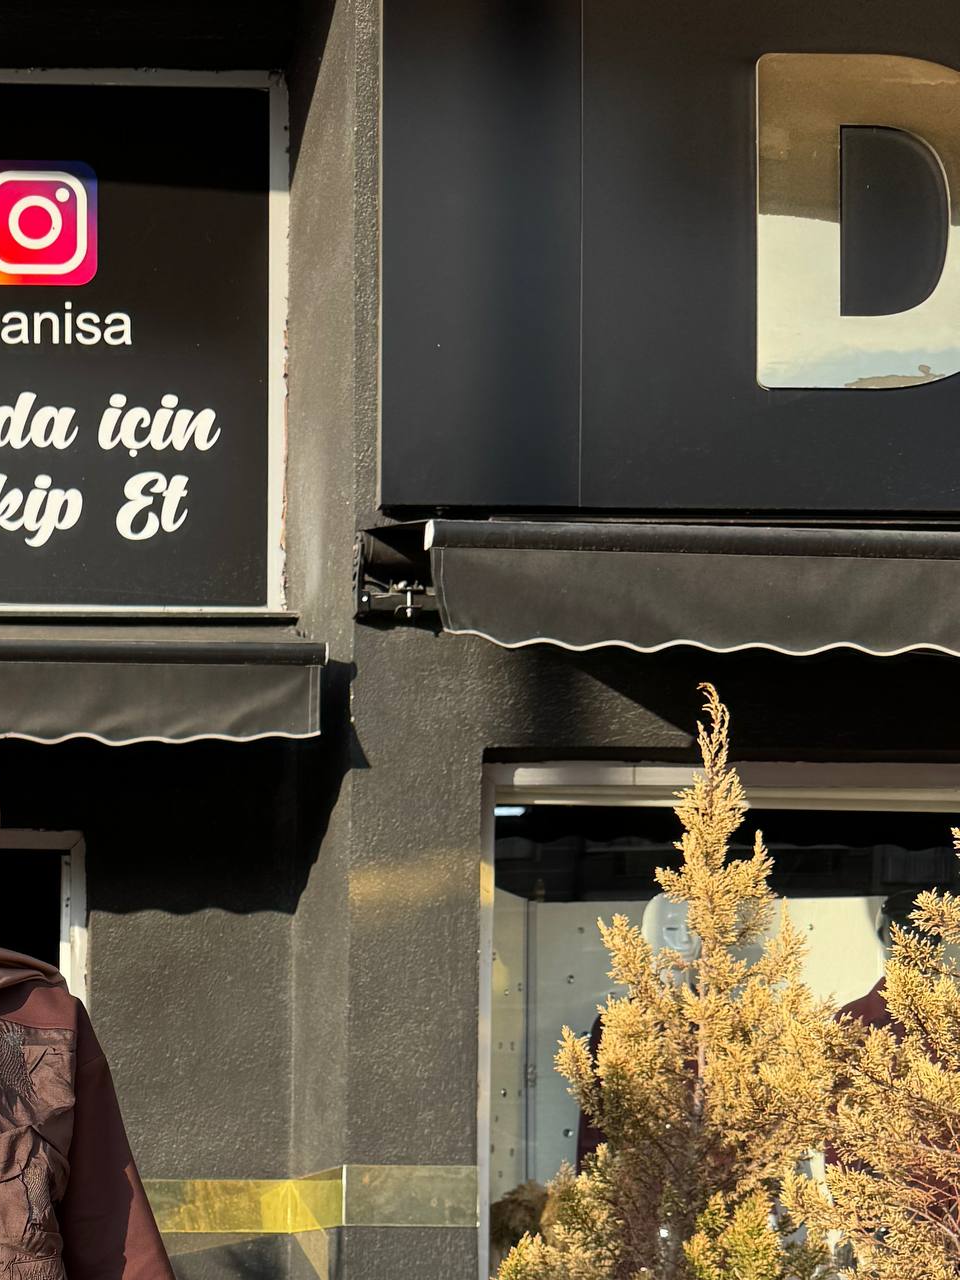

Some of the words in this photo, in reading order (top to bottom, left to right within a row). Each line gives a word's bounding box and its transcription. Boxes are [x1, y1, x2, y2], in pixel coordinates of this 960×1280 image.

[756, 53, 960, 390] D
[97, 393, 222, 458] için
[115, 471, 189, 541] Et
